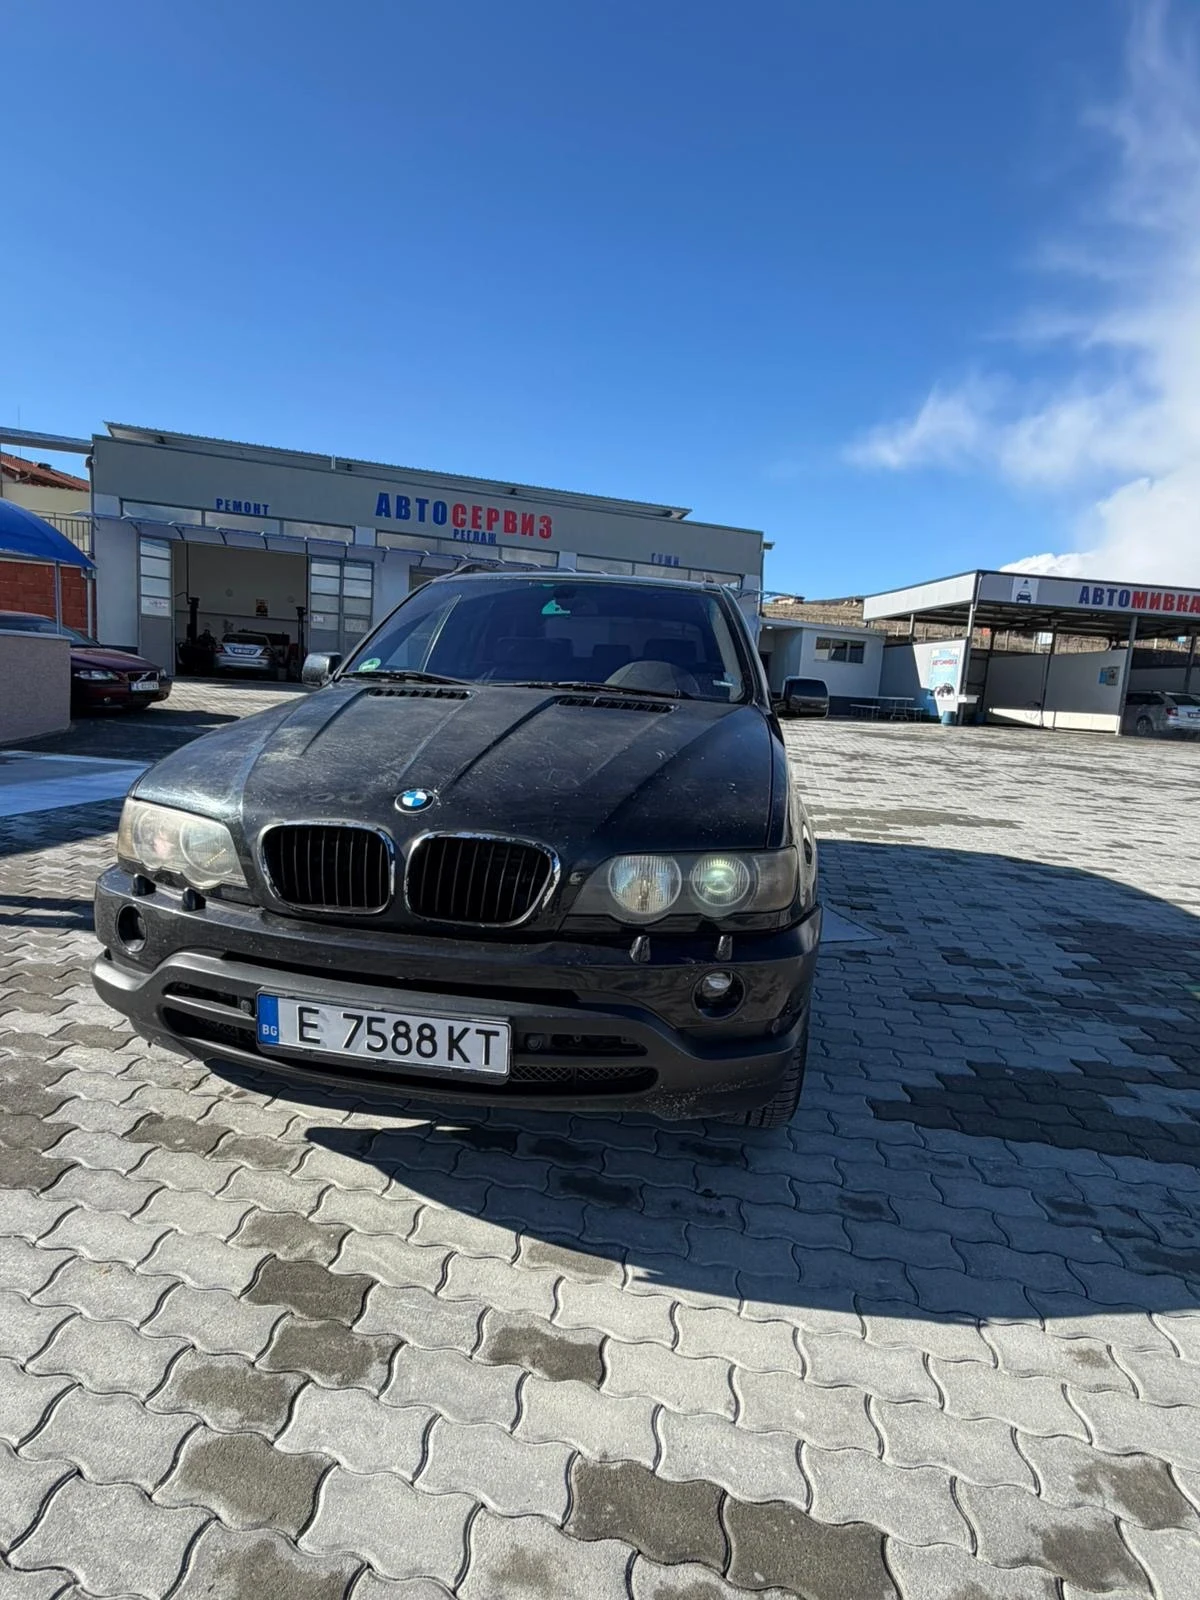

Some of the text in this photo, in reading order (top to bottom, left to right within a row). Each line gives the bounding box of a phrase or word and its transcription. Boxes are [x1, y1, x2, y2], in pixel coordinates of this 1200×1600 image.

[215, 498, 270, 516] РЕМОНТ
[375, 492, 553, 540] АВТОСЕРВИЗ
[453, 528, 497, 544] РЕГЛАЖ
[1078, 585, 1200, 614] АВТОМИВКА
[261, 1023, 278, 1037] BG
[341, 1012, 438, 1059] 7588
